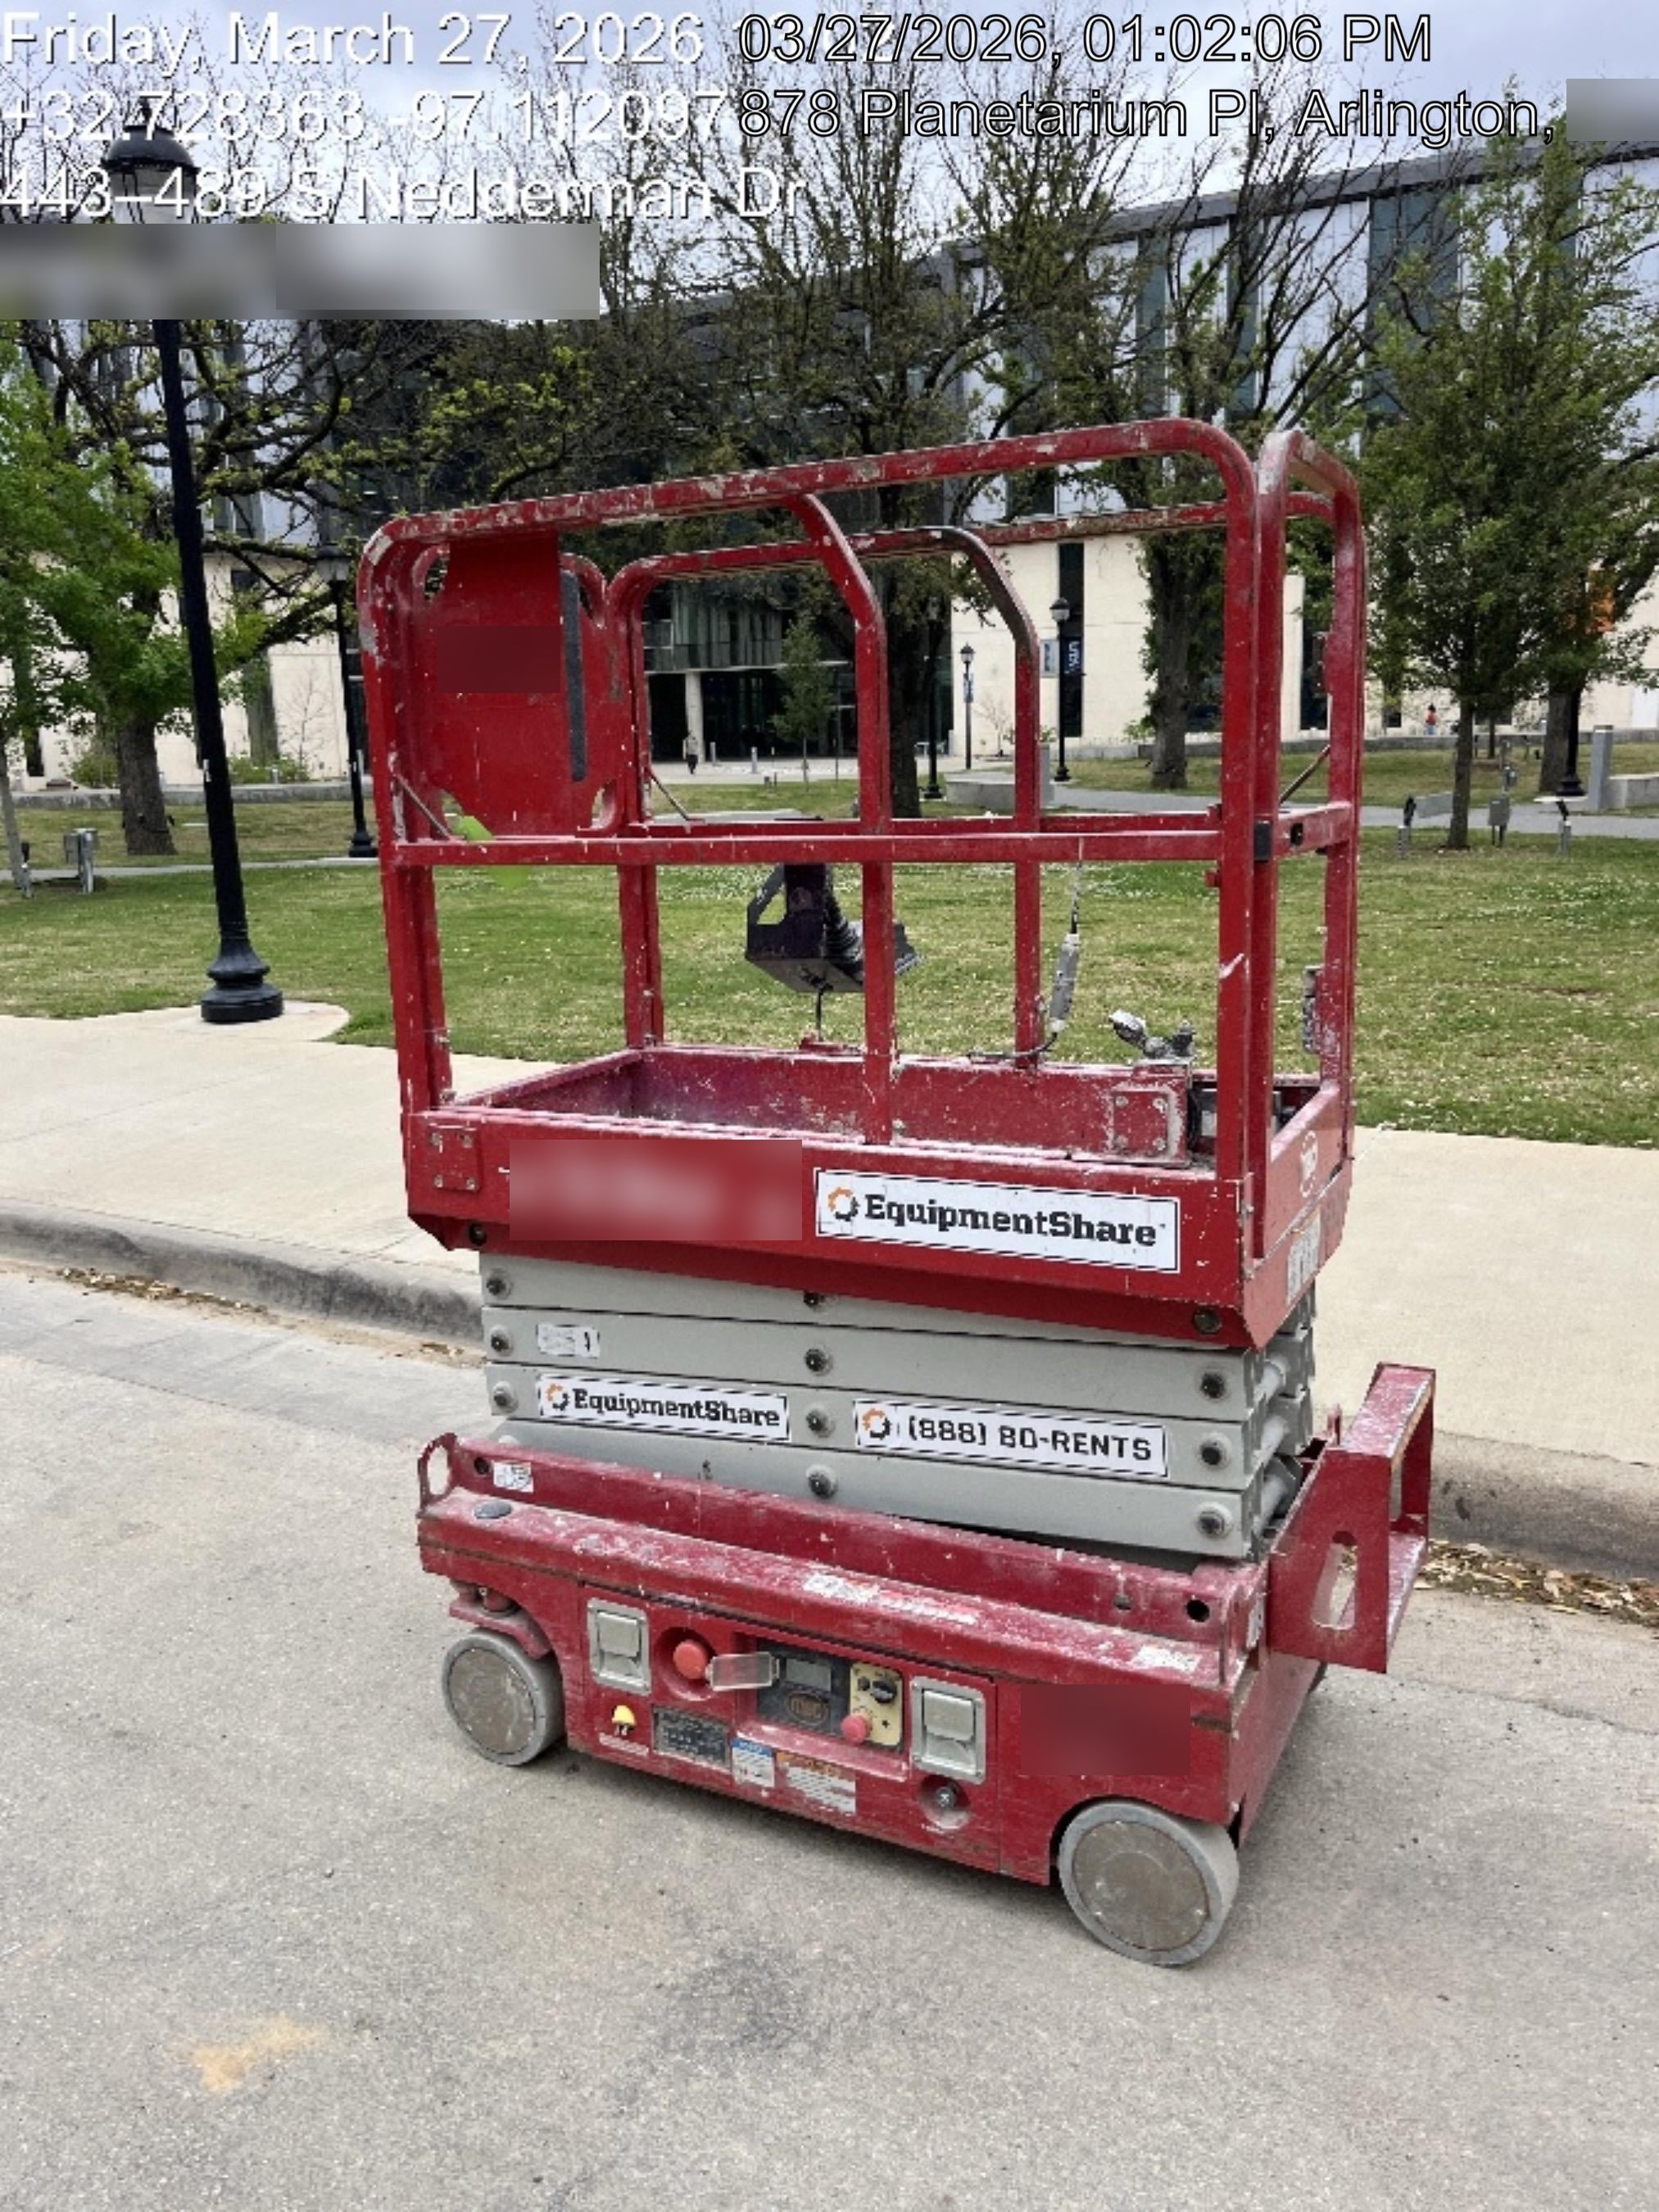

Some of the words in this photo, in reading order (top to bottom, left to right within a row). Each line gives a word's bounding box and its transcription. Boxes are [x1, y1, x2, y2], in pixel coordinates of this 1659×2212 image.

[864, 1194, 1158, 1248] EquipmentShare
[572, 1388, 781, 1428] EquipmentShare
[908, 1415, 987, 1446] (888)
